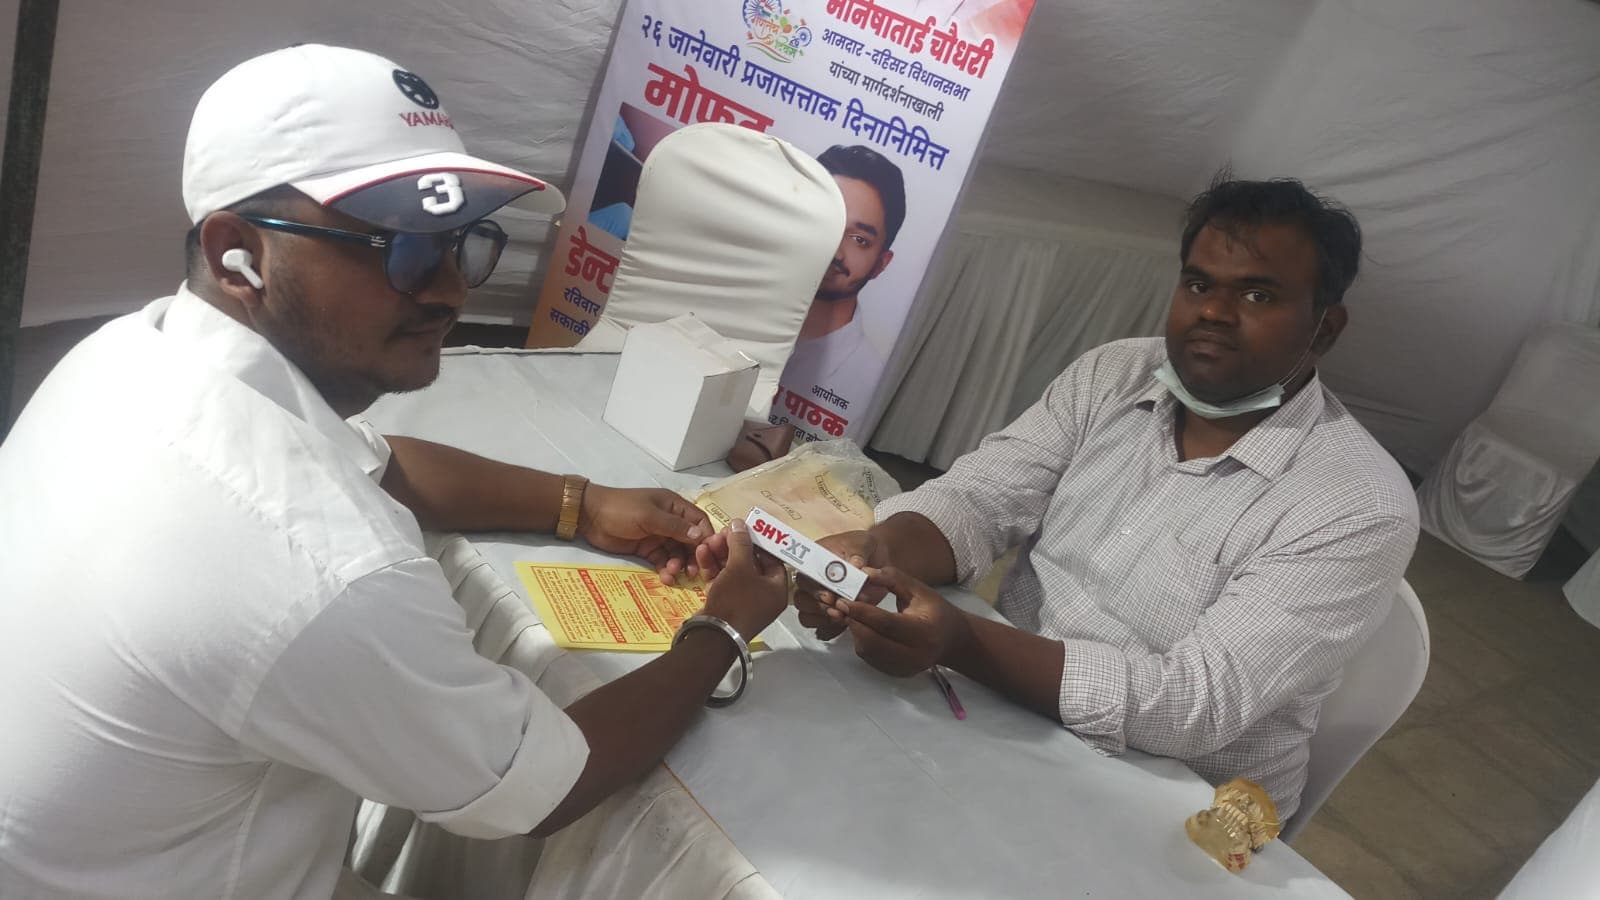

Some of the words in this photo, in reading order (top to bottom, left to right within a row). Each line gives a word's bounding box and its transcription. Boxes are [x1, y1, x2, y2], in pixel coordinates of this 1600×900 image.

[822, 28, 864, 57] आमदार
[908, 61, 971, 101] विधानसभा
[930, 22, 995, 79] चौधरी
[642, 15, 663, 47] २६
[668, 27, 741, 78] जानेवारी
[741, 60, 842, 122] प्रजासत्ताक
[842, 98, 950, 170] दिनानिमित्त
[829, 61, 861, 86] यांच्या
[862, 75, 944, 121] मार्गदर्शनाखाली
[417, 172, 464, 215] 3
[565, 225, 620, 294] डेन्ट
[564, 287, 600, 316] रविवार
[785, 390, 848, 437] पाठक
[812, 385, 849, 410] आयोजक
[752, 518, 811, 560] SHY-XT
